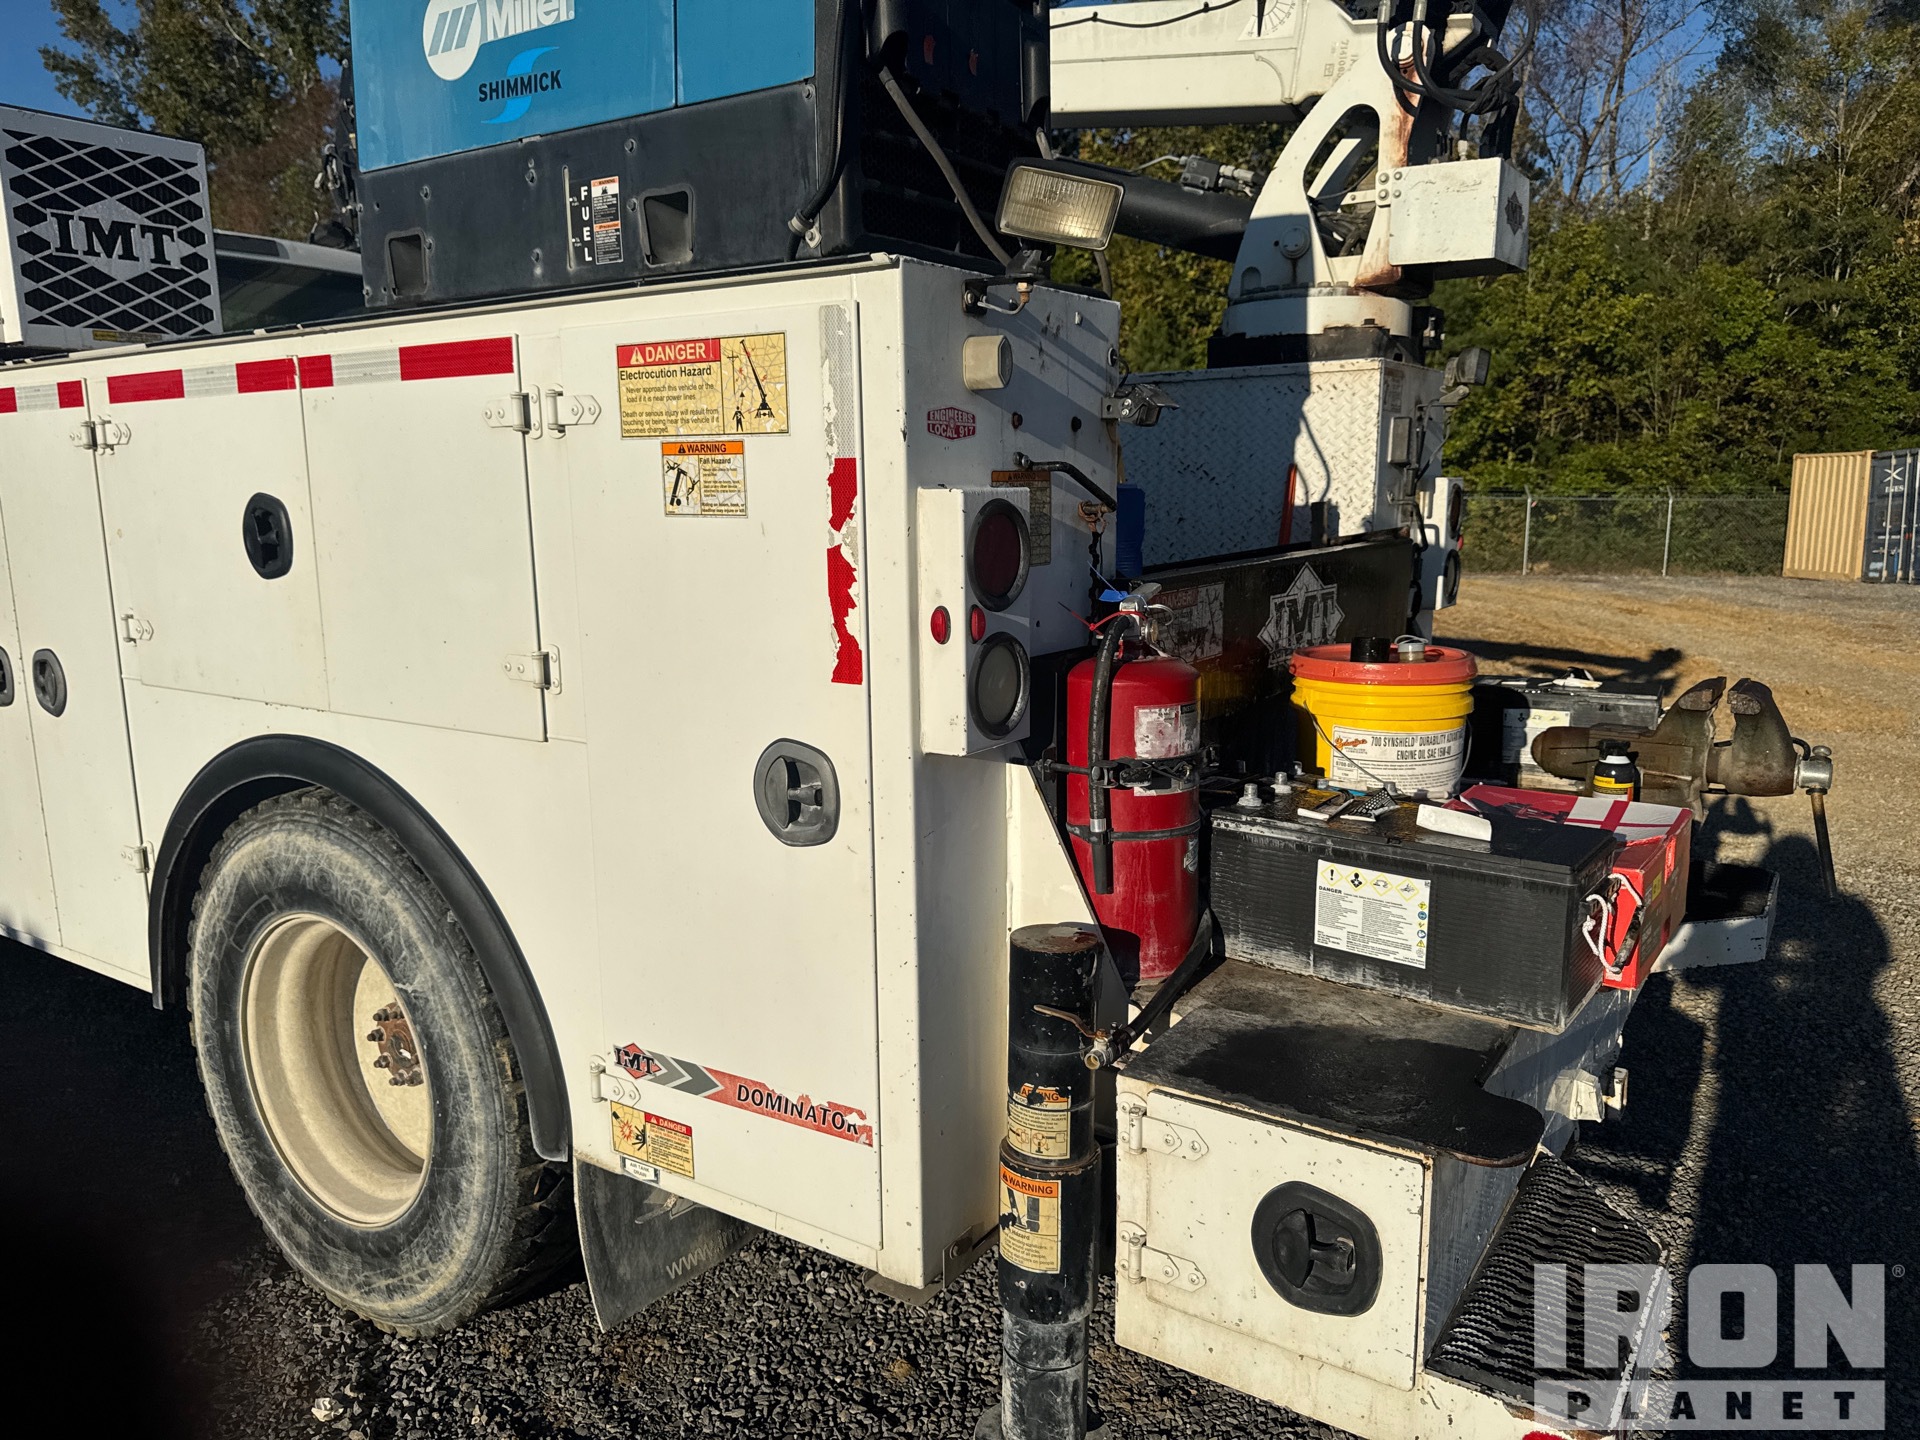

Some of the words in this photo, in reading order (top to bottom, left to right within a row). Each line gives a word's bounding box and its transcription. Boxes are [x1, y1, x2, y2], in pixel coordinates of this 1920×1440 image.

[478, 70, 562, 102] SHIMMICK
[50, 213, 175, 265] IMT
[646, 342, 706, 362] DANGER
[620, 367, 677, 380] Electrocution
[680, 365, 712, 377] Hazard
[930, 409, 973, 422] ENGINEERS
[930, 424, 957, 437] LOCAL
[960, 426, 973, 437] 917
[687, 444, 726, 453] WARNING
[1371, 737, 1381, 746] 700
[1383, 736, 1415, 747] SYNSHIELD
[1419, 734, 1446, 746] DURABILITY
[1396, 750, 1417, 760] ENGINE
[1418, 749, 1426, 759] OIL
[1427, 748, 1436, 758] SAE
[1319, 886, 1342, 894] DANGER
[614, 1047, 655, 1075] IMT
[660, 1119, 686, 1133] DANGER
[1009, 1176, 1053, 1195] WARNING
